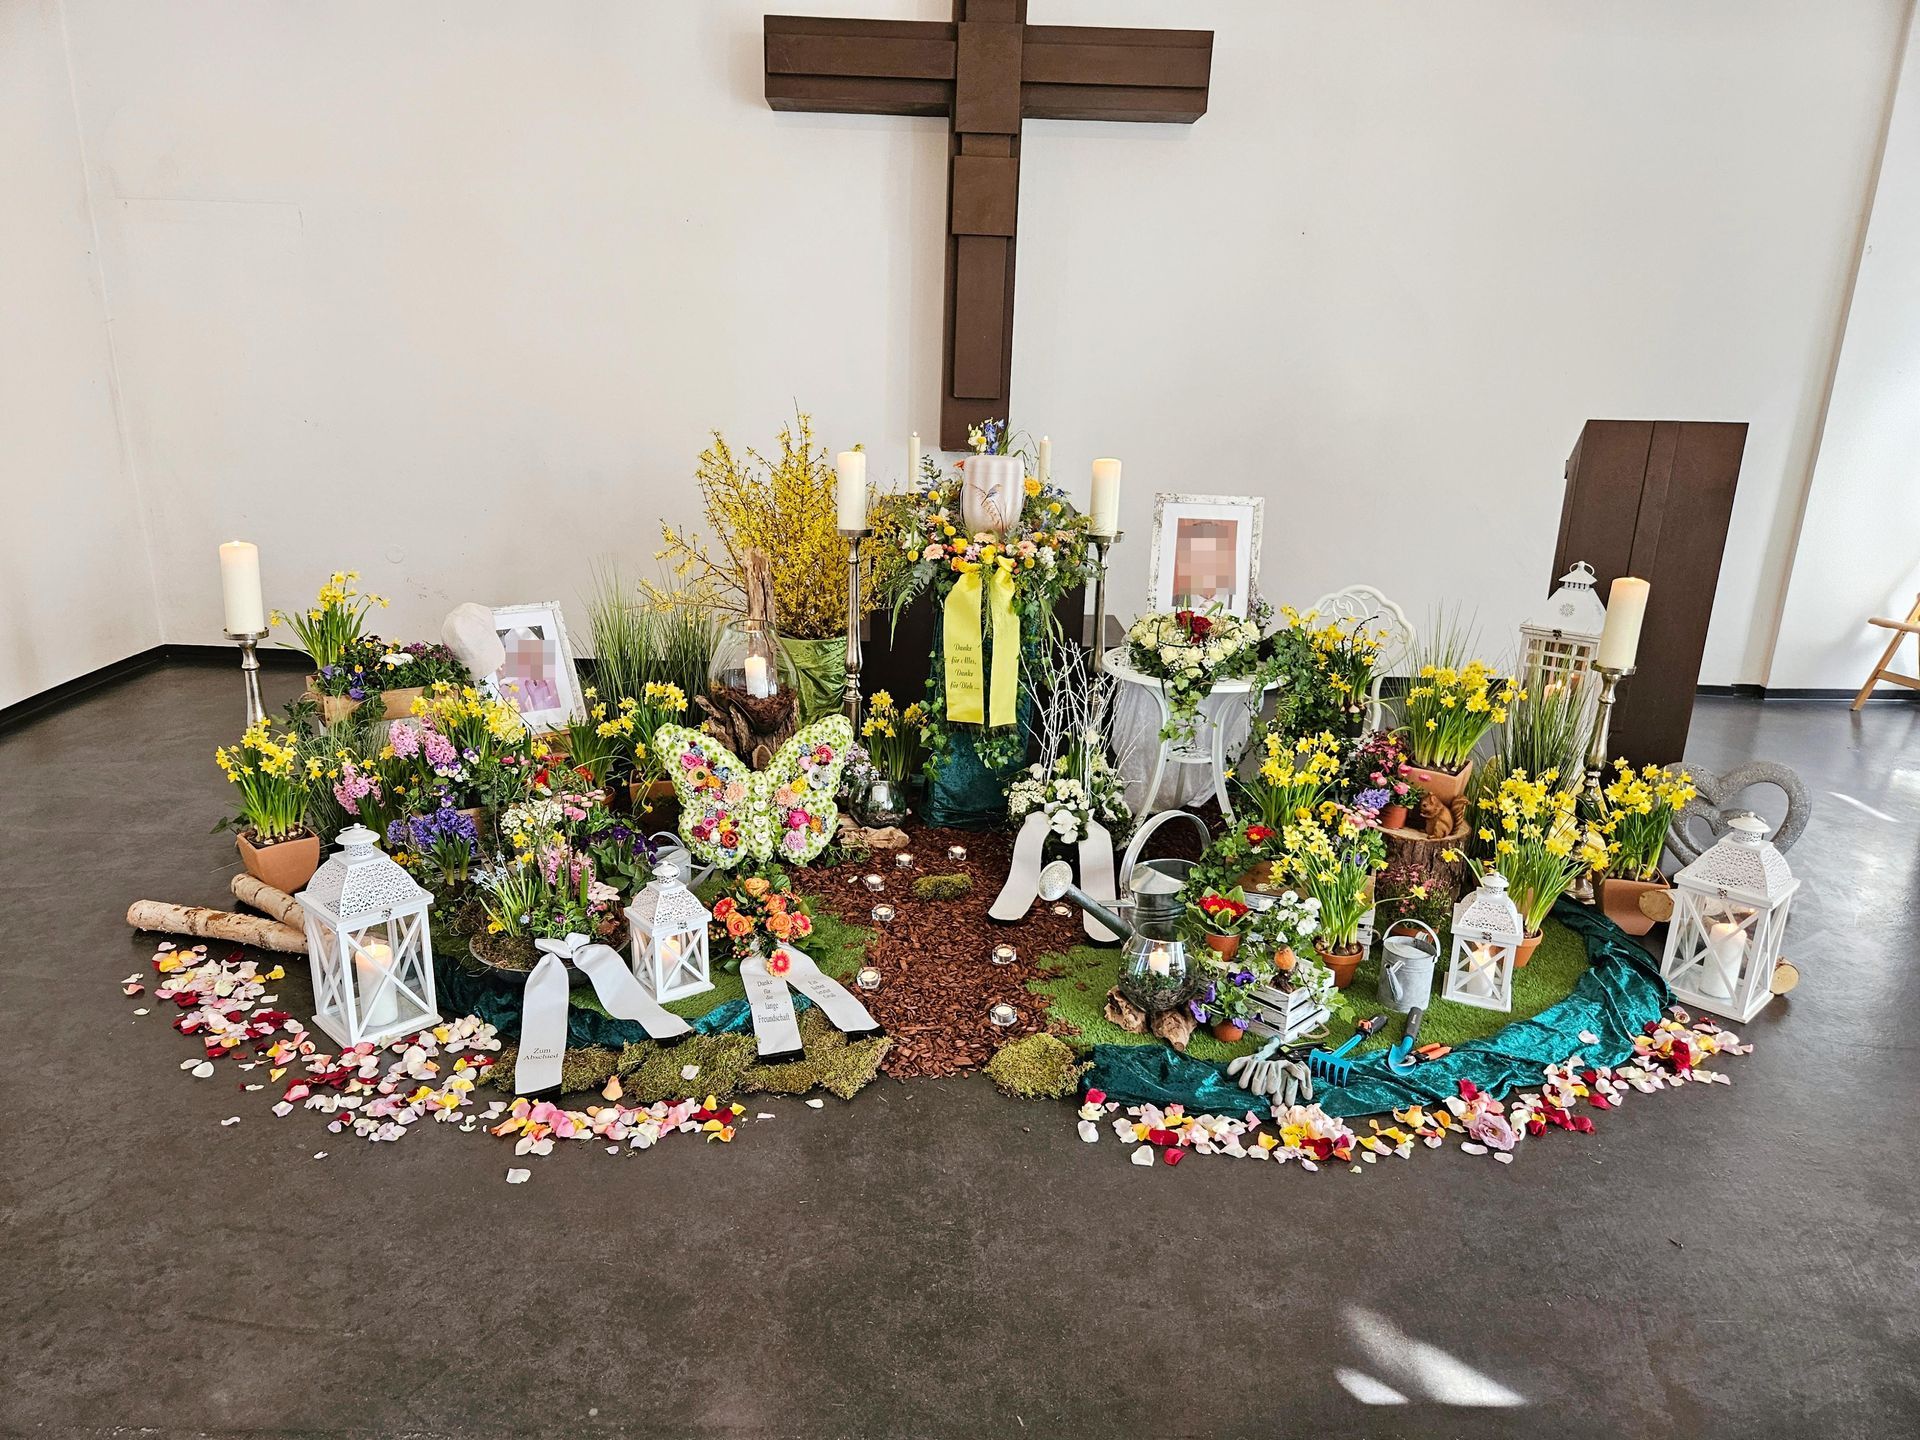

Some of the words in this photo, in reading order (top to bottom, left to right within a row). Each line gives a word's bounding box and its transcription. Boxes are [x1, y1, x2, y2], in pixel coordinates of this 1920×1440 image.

[953, 643, 972, 651] Danke
[951, 656, 960, 664] für
[955, 669, 974, 677] Danke
[950, 681, 959, 689] für
[764, 1002, 779, 1011] lange
[758, 1013, 790, 1023] Freundschaft
